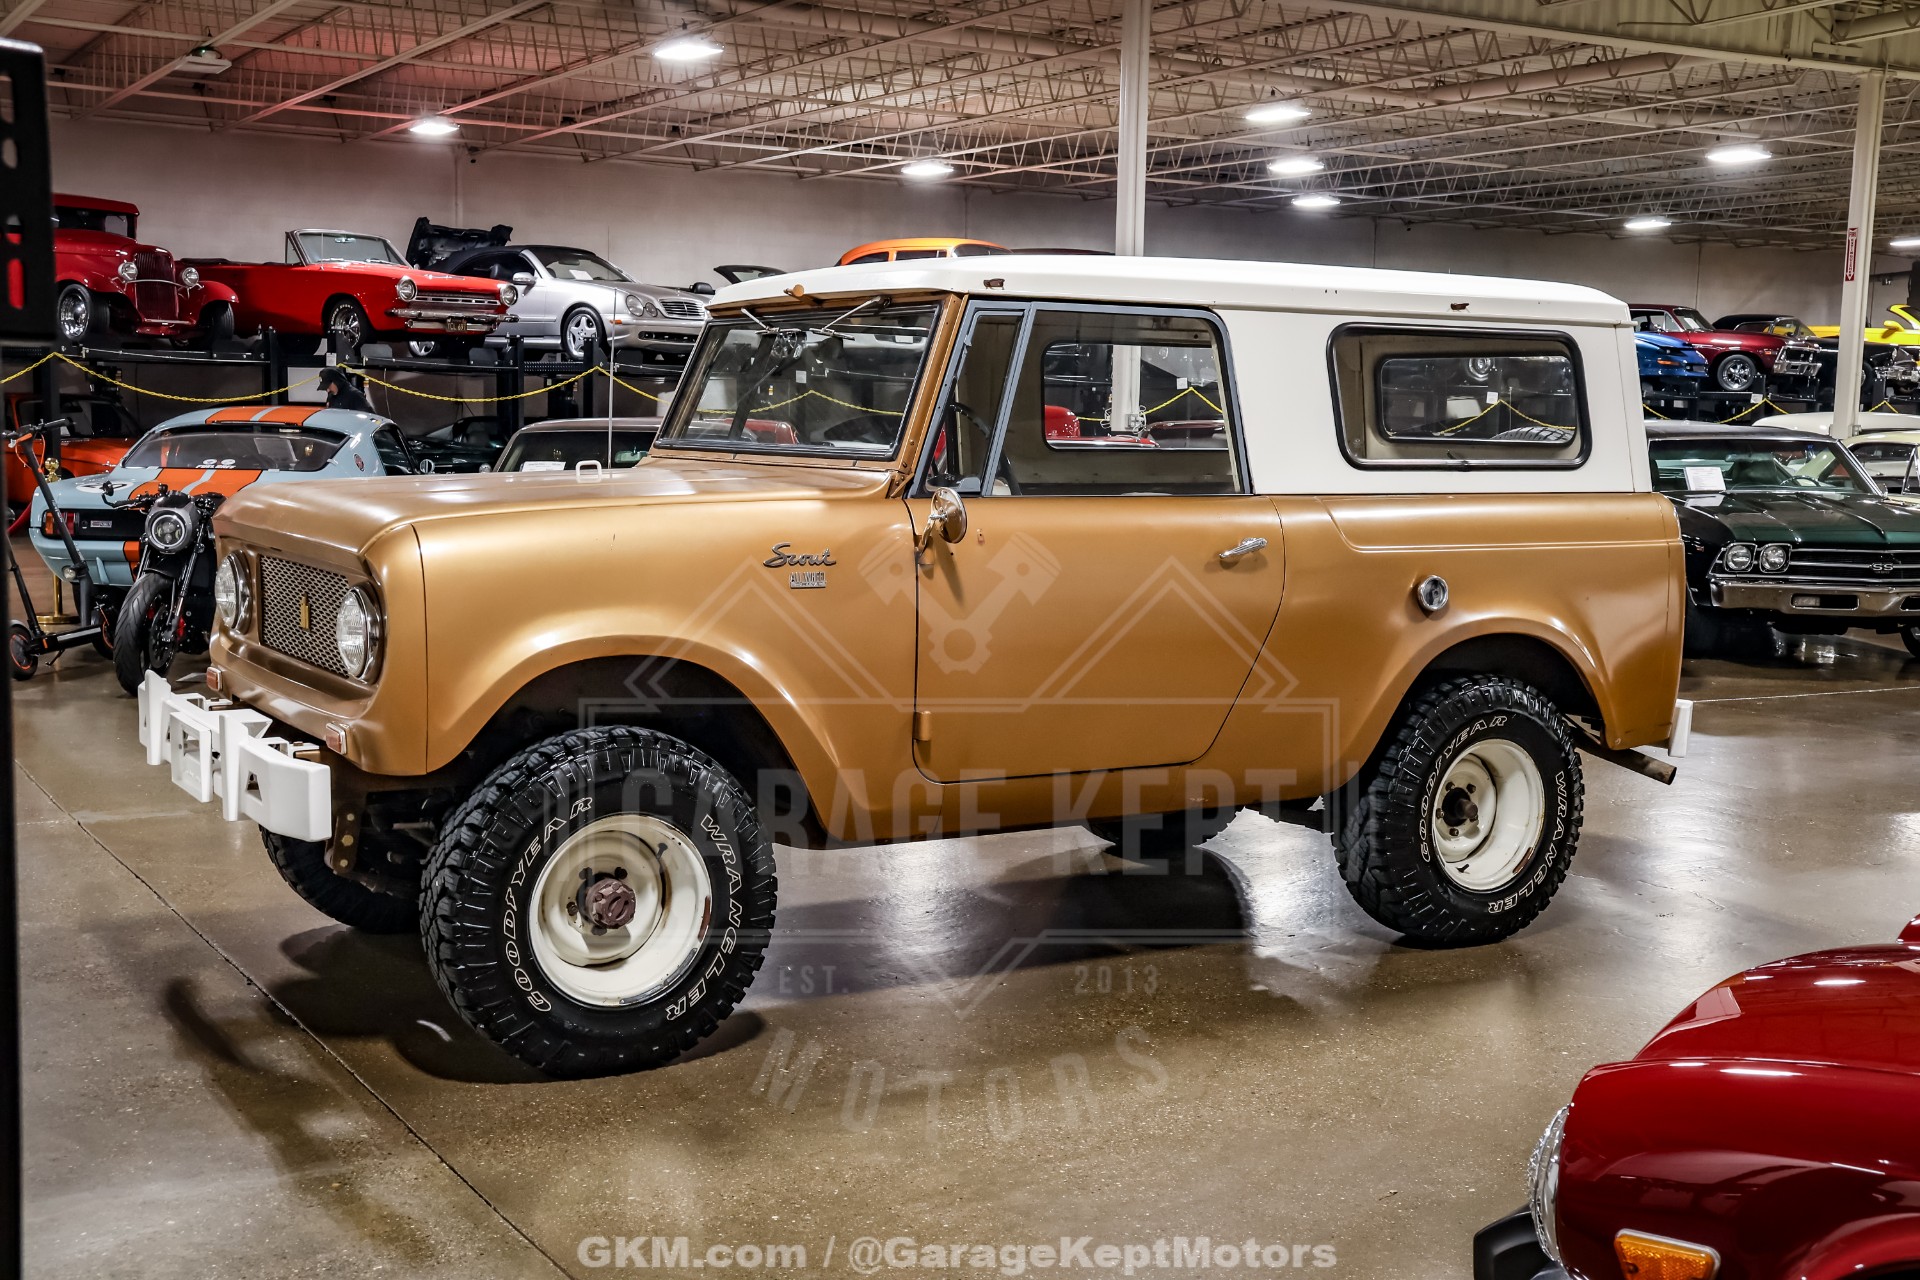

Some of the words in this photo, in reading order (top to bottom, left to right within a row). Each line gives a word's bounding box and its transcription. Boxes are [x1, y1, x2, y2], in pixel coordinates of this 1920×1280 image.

[763, 541, 837, 568] Scout
[1872, 563, 1894, 571] SS
[1419, 715, 1508, 863] GOODYEAR
[1488, 771, 1568, 914] WRANGLER
[503, 797, 593, 1012] GOODYEAR
[665, 814, 743, 1021] WRANGLER
